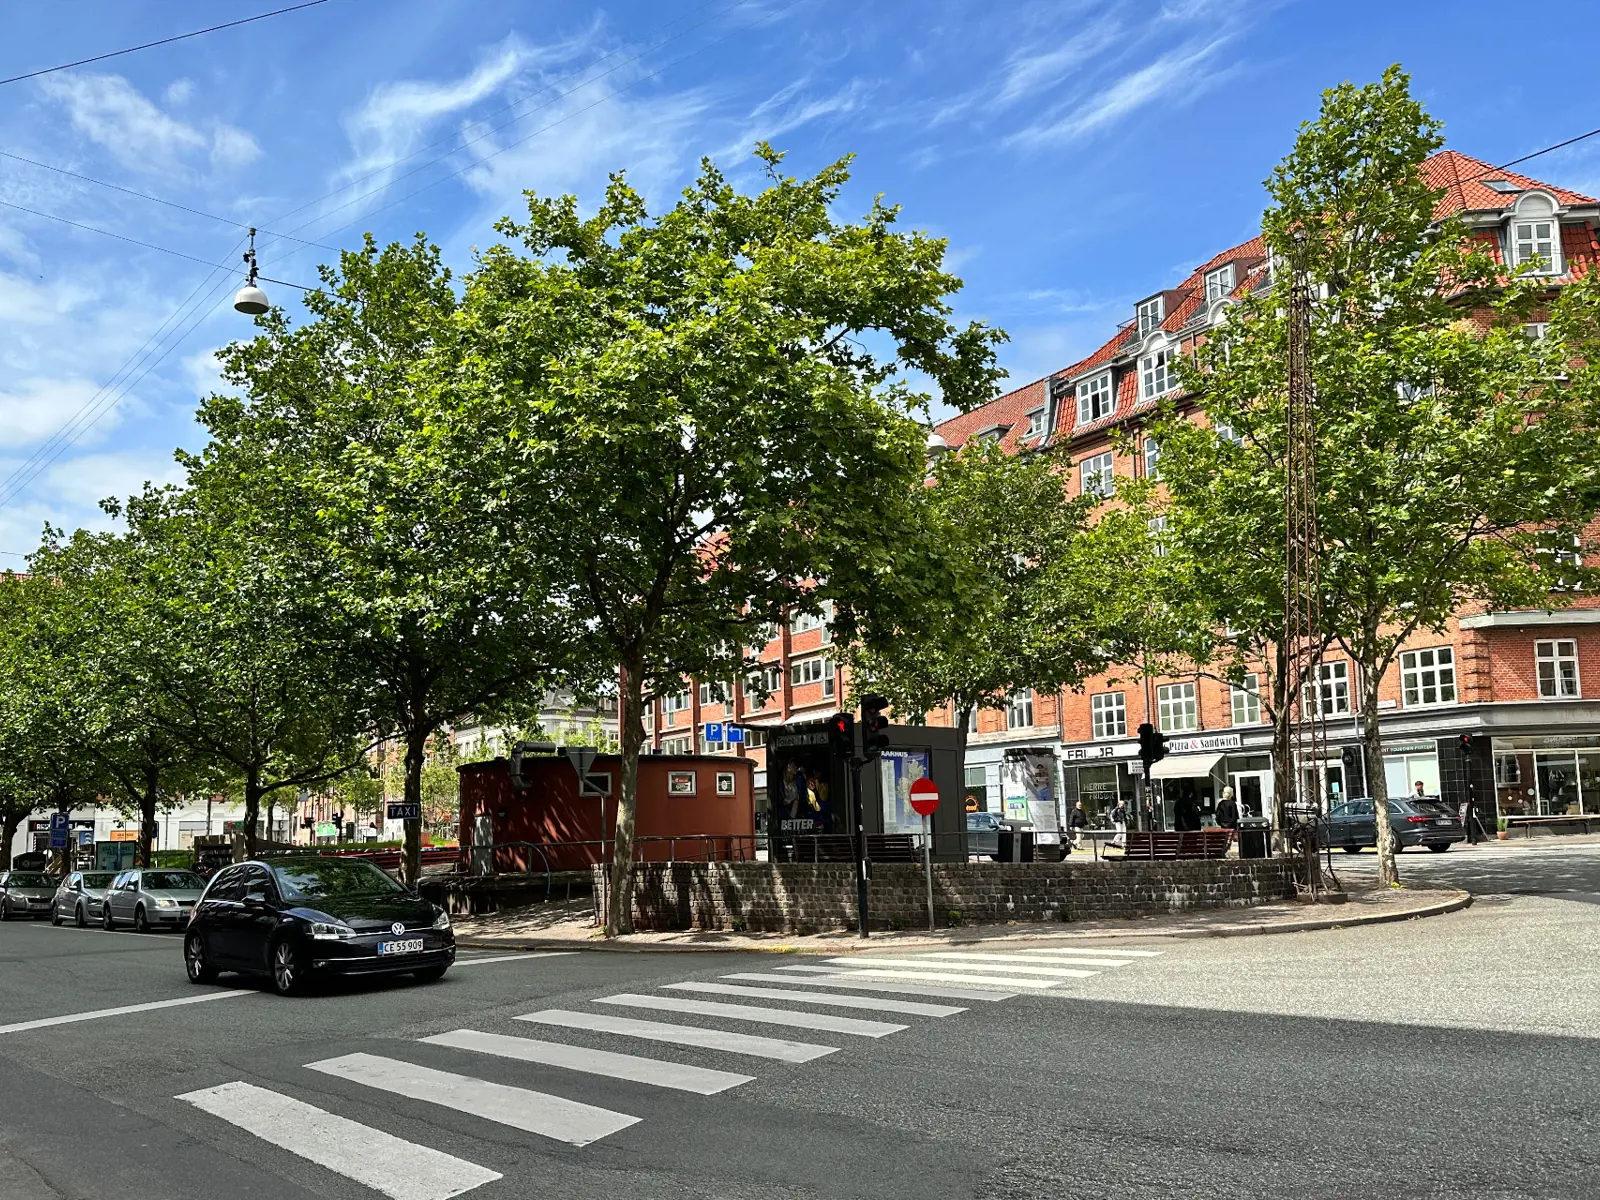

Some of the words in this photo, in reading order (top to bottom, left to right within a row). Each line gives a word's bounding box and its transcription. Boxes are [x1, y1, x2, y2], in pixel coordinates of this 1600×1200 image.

[710, 724, 719, 736] P
[1190, 739, 1199, 749] &
[1200, 736, 1239, 749] Sandwich
[1067, 747, 1114, 760] FRIR
[1083, 781, 1107, 791] HERRE
[390, 806, 417, 817] TAXI
[55, 816, 66, 829] P
[781, 819, 814, 831] BETTER
[384, 943, 395, 953] CE
[396, 942, 407, 951] 55
[407, 940, 422, 950] 909
